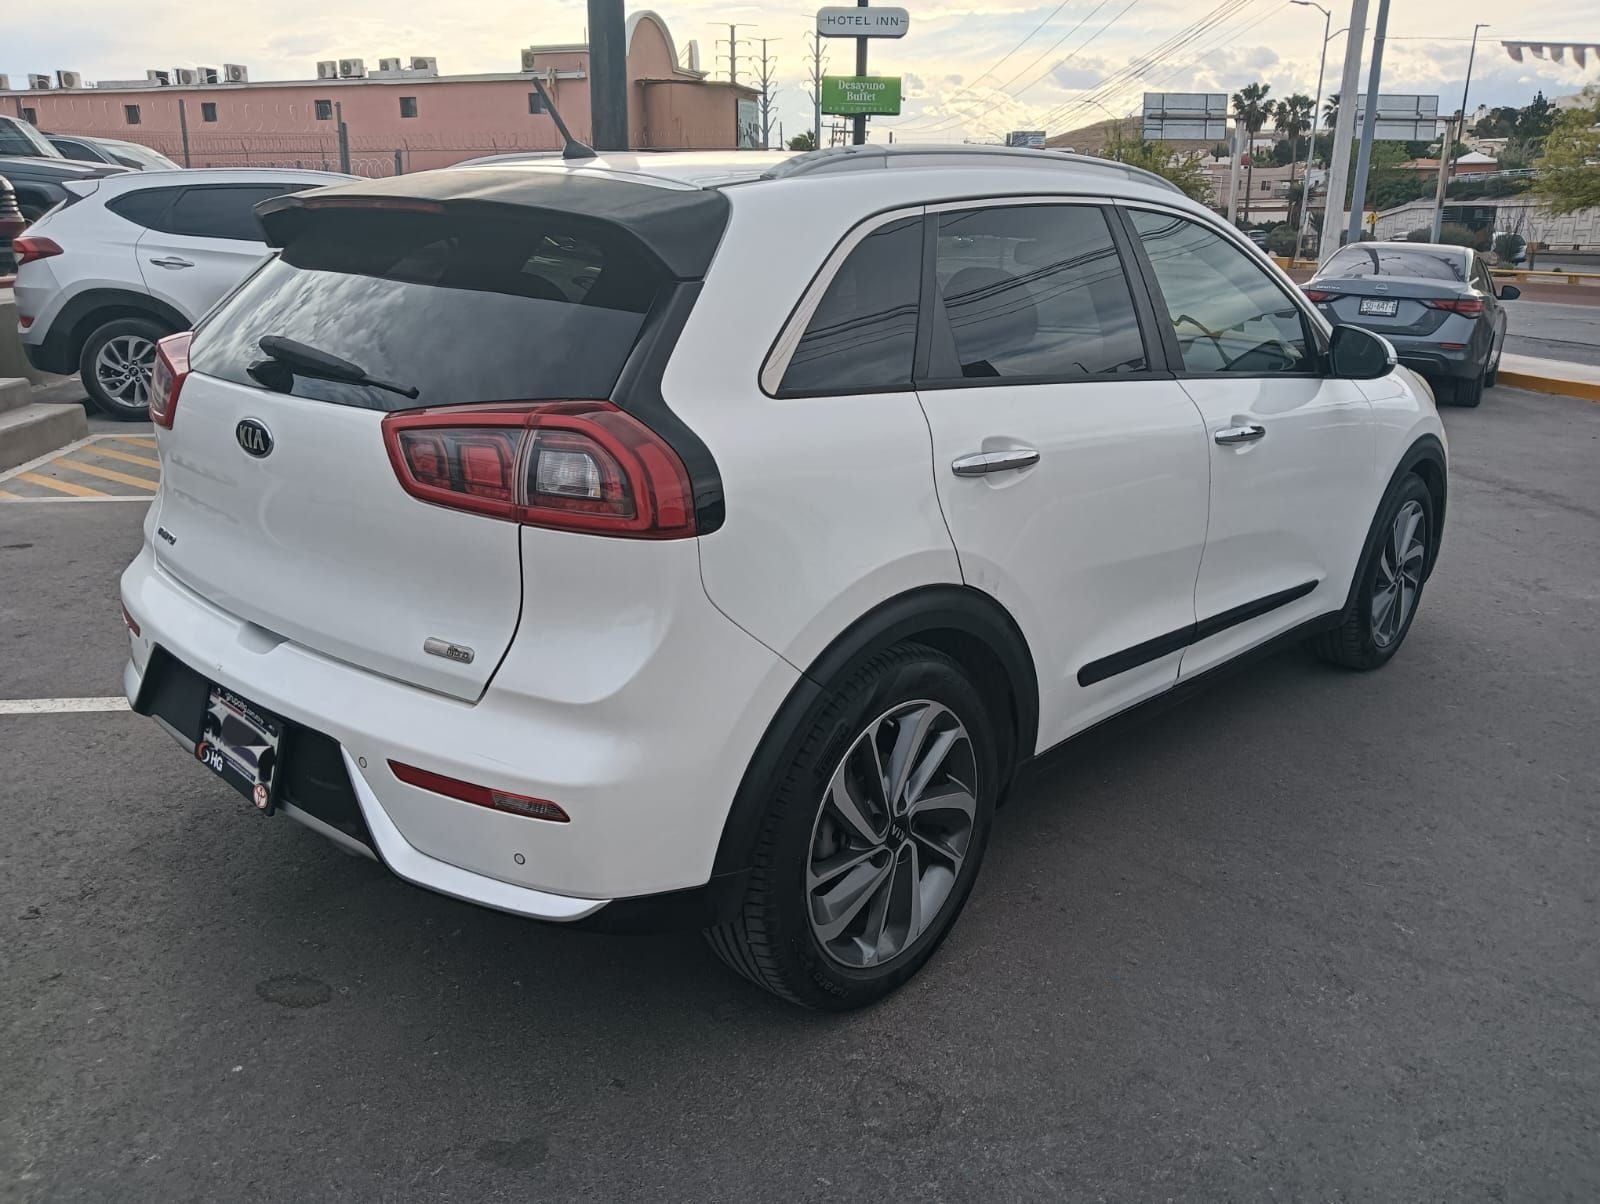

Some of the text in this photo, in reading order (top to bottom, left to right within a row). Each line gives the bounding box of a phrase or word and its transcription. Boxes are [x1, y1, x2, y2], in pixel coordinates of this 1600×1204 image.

[827, 15, 900, 26] HOTEL INN
[838, 79, 886, 92] Desayuno
[846, 91, 876, 102] Buffet
[240, 424, 265, 451] KIA
[209, 750, 224, 772] HG
[891, 823, 906, 842] KIA
